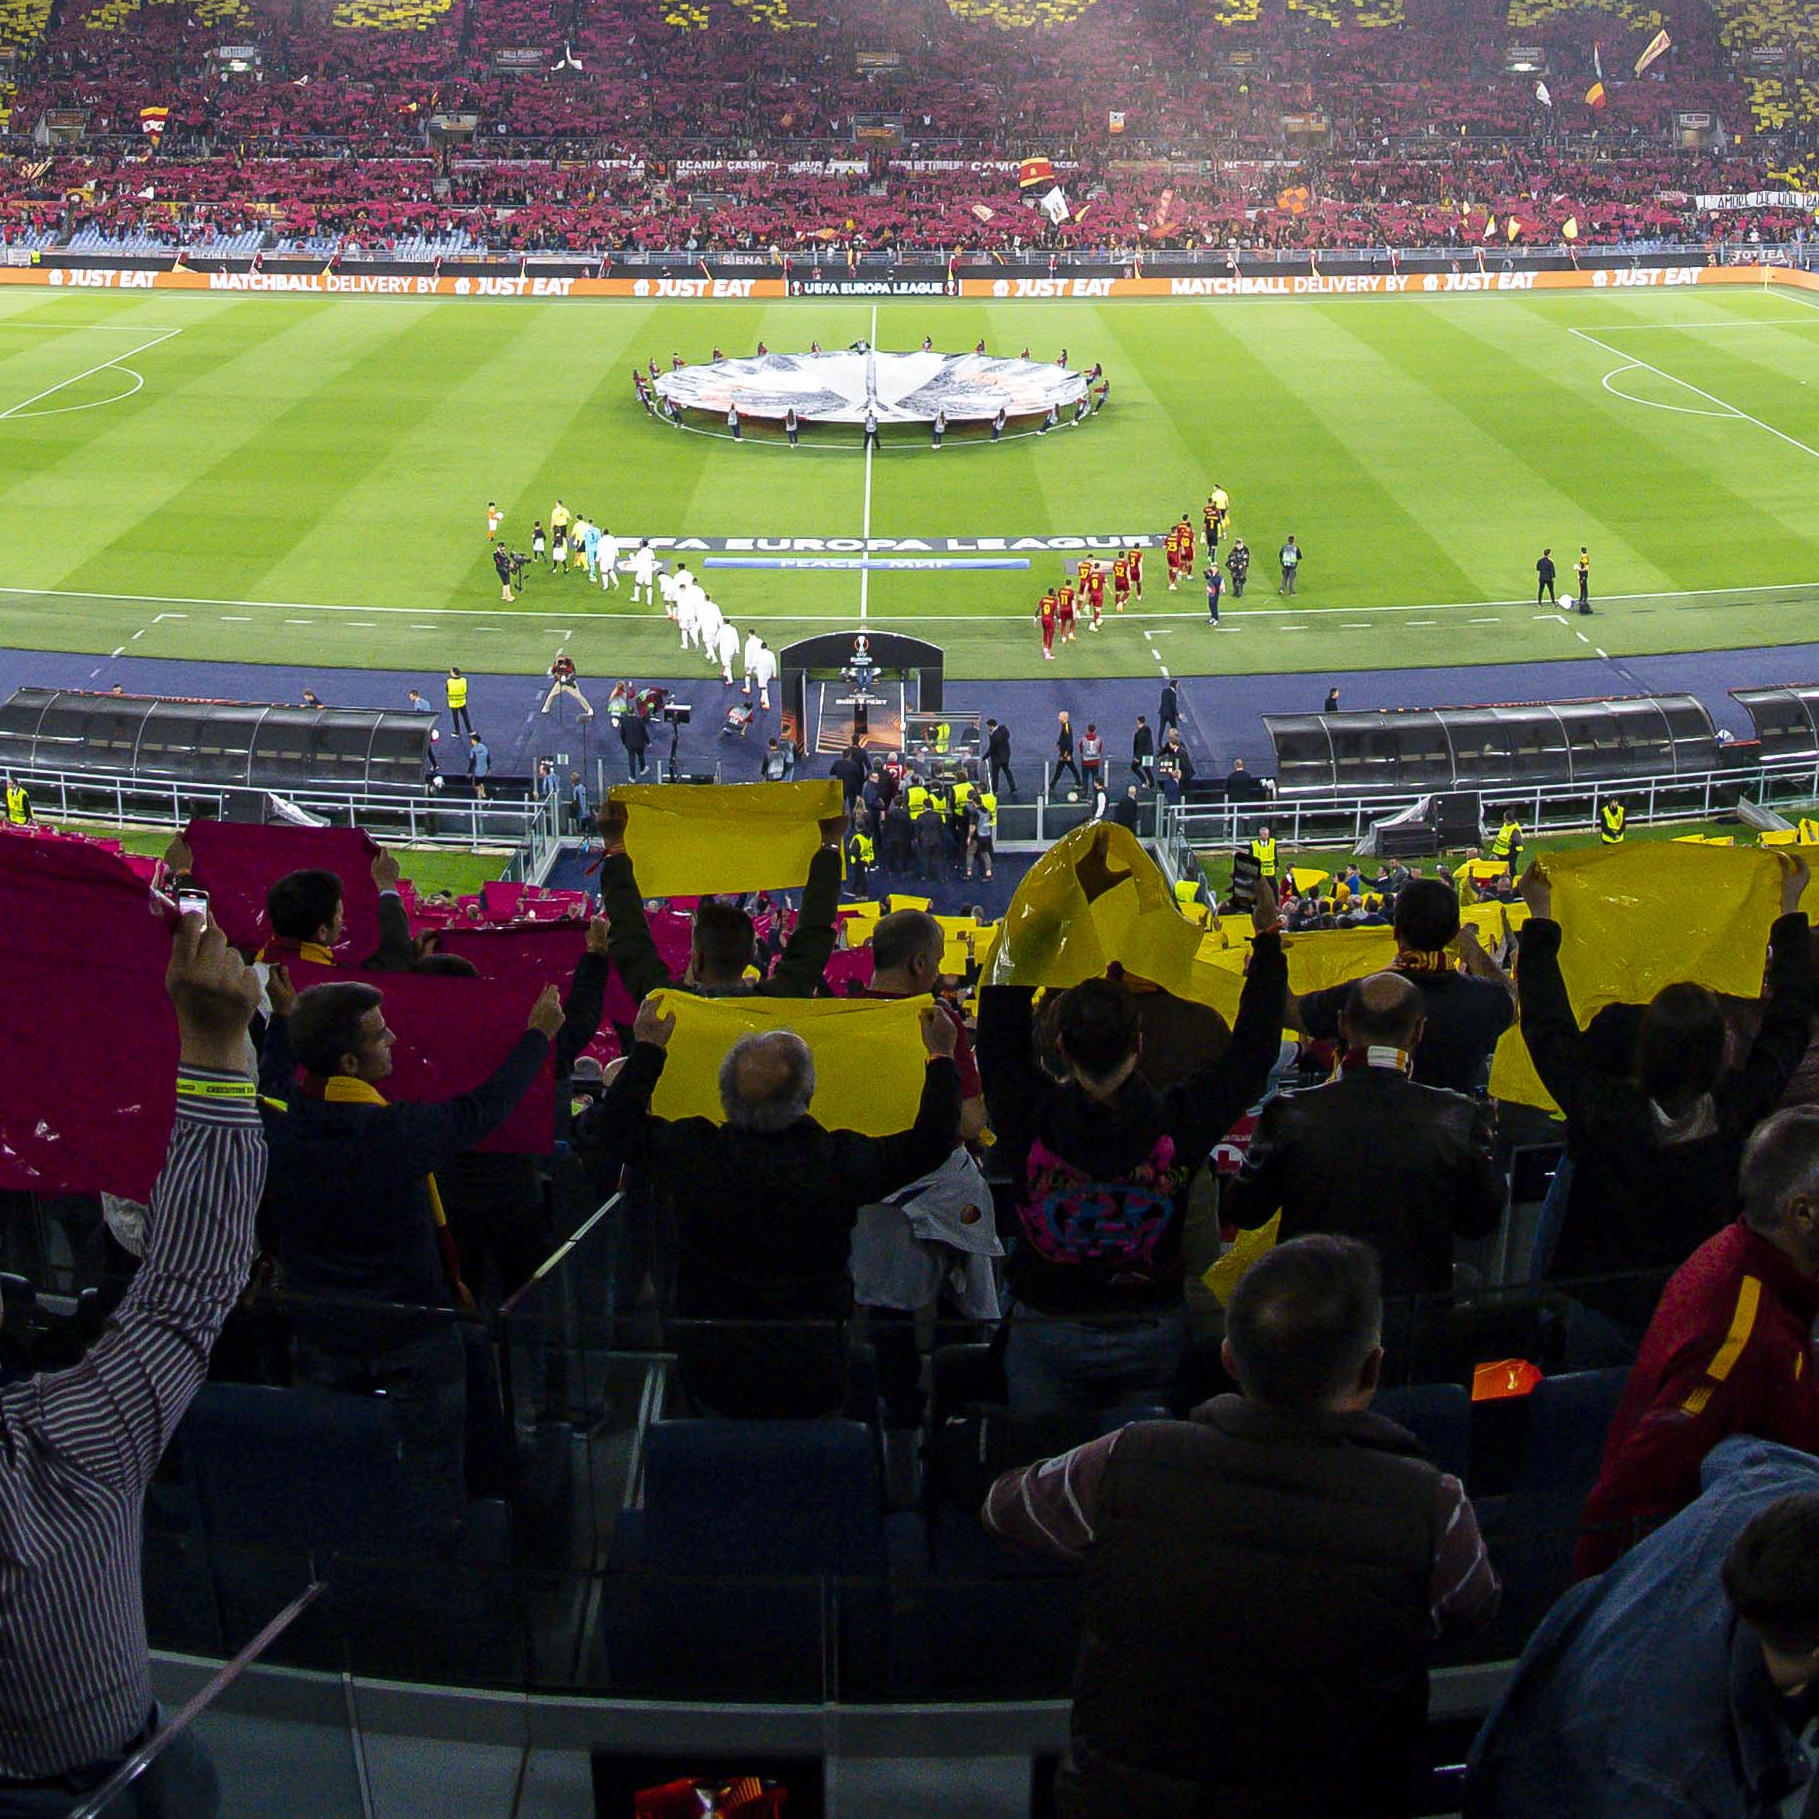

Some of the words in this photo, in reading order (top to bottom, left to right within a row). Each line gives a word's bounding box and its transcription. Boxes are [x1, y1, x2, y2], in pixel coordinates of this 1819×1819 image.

[722, 255, 763, 266] SIENA
[68, 269, 115, 287] JUST
[119, 271, 159, 288] EAT
[210, 274, 322, 291] MATCHBALL
[326, 276, 414, 292] DELIVERY
[416, 276, 441, 293] BY
[1171, 277, 1290, 295] MATCHBALL
[1294, 276, 1383, 293] DELIVERY
[1384, 274, 1409, 291] BY
[1444, 273, 1494, 290] JUST
[1497, 271, 1539, 289] EAT
[1612, 269, 1663, 286] JUST
[1664, 267, 1704, 285] EAT
[475, 277, 529, 295] JUST
[531, 278, 576, 295] EAT
[655, 279, 712, 296] JUST
[712, 279, 757, 296] EAT
[804, 282, 839, 294] UEFA
[841, 282, 889, 294] EUROPA
[893, 282, 944, 294] LEAGUE
[1015, 279, 1068, 296] JUST
[1071, 279, 1115, 296] EAT
[614, 538, 711, 550] EFA
[725, 538, 932, 551] EUROPA
[947, 536, 1153, 550] LEAGUE
[1060, 594, 1069, 605] 11
